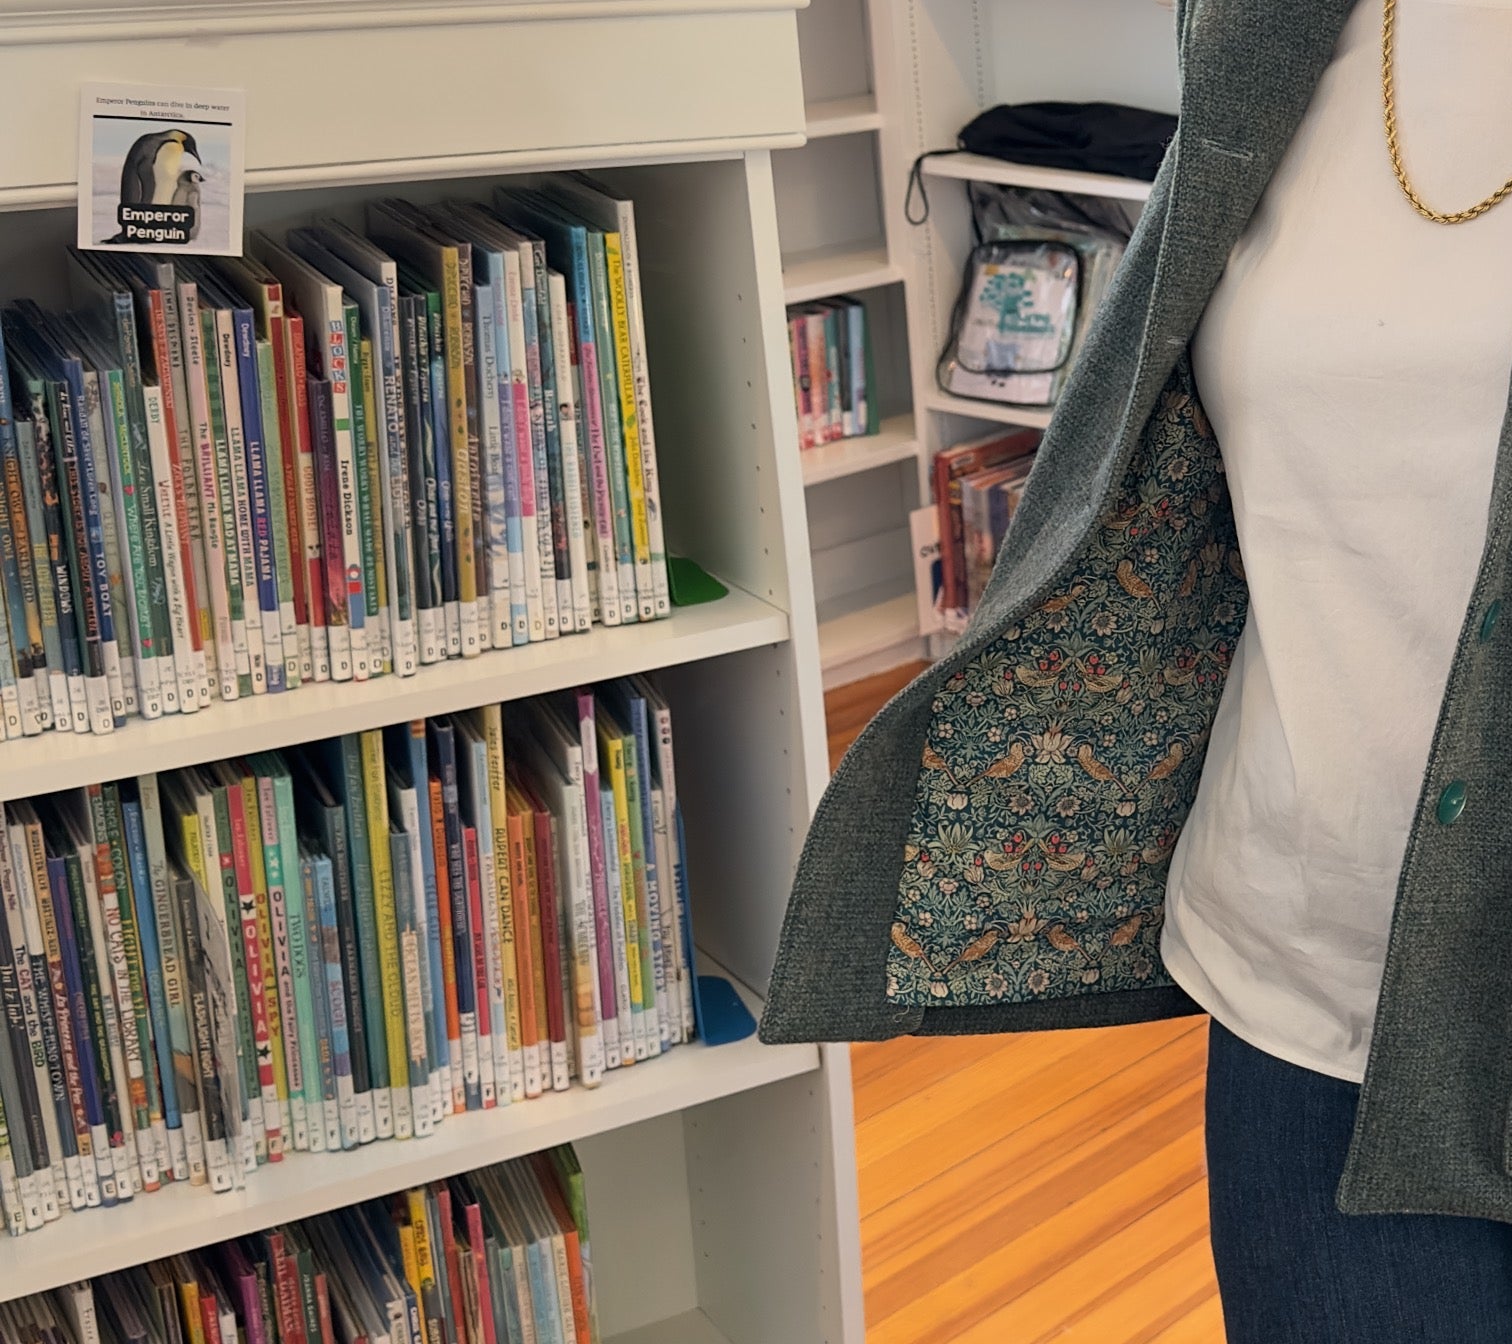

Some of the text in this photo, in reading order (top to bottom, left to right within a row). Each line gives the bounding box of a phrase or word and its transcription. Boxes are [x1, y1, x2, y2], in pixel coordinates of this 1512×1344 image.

[96, 97, 124, 106] Emperor
[125, 98, 156, 108] Penguins
[194, 103, 210, 111] deep
[122, 207, 189, 223] Emperor
[126, 225, 185, 242] Penguin
[148, 396, 159, 424] DERBY
[251, 441, 272, 581] LLAMA LLAMA RED PAJAMA
[341, 460, 354, 536] Irene Dickson
[57, 564, 73, 616] WINDOWS
[97, 552, 112, 619] TOY BOAT
[496, 828, 514, 945] RUPERT CAN DANCE
[154, 877, 180, 1009] GINGERBREAD GIRL
[272, 890, 291, 977] OLIVIA
[15, 944, 26, 968] The
[32, 1040, 45, 1069] BIRD
[245, 924, 269, 1034] OLIVIA
